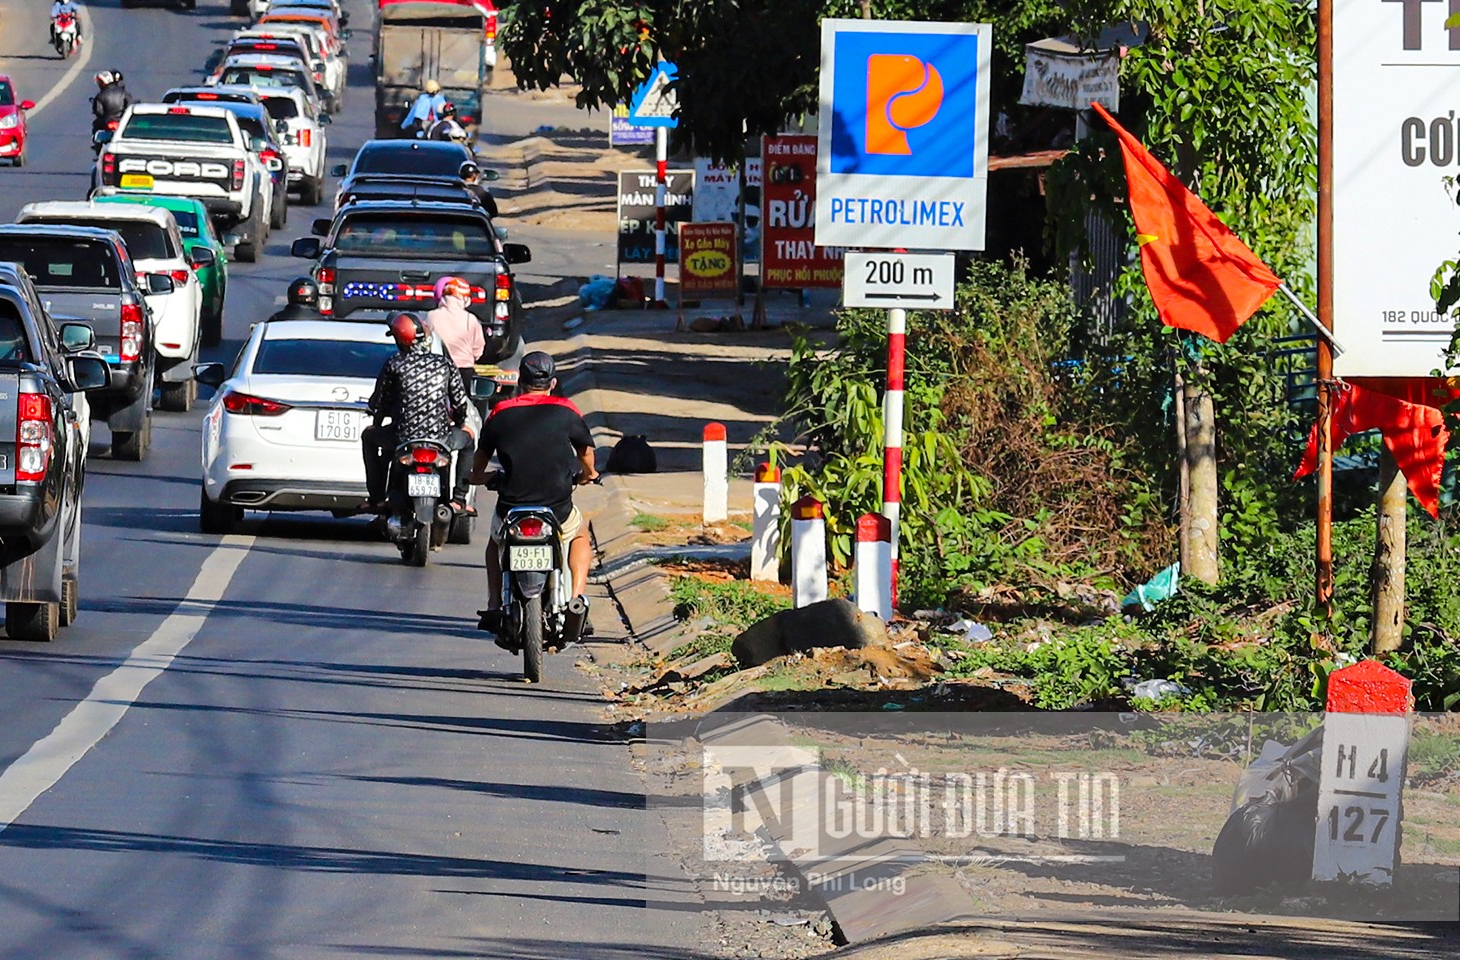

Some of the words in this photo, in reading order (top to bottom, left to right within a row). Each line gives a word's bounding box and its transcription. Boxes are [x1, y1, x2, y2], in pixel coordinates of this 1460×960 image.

[1401, 110, 1460, 168] CƠ
[119, 159, 229, 178] FORD
[621, 188, 653, 206] MÀN
[830, 198, 965, 228] PETROLIMEX
[775, 240, 816, 259] THAY
[865, 260, 905, 285] 200
[913, 267, 934, 285] m
[1382, 310, 1406, 323] 182
[328, 412, 350, 426] 51G
[516, 546, 545, 558] 49-F1
[513, 558, 550, 570] 203.87
[1328, 805, 1390, 844] 127
